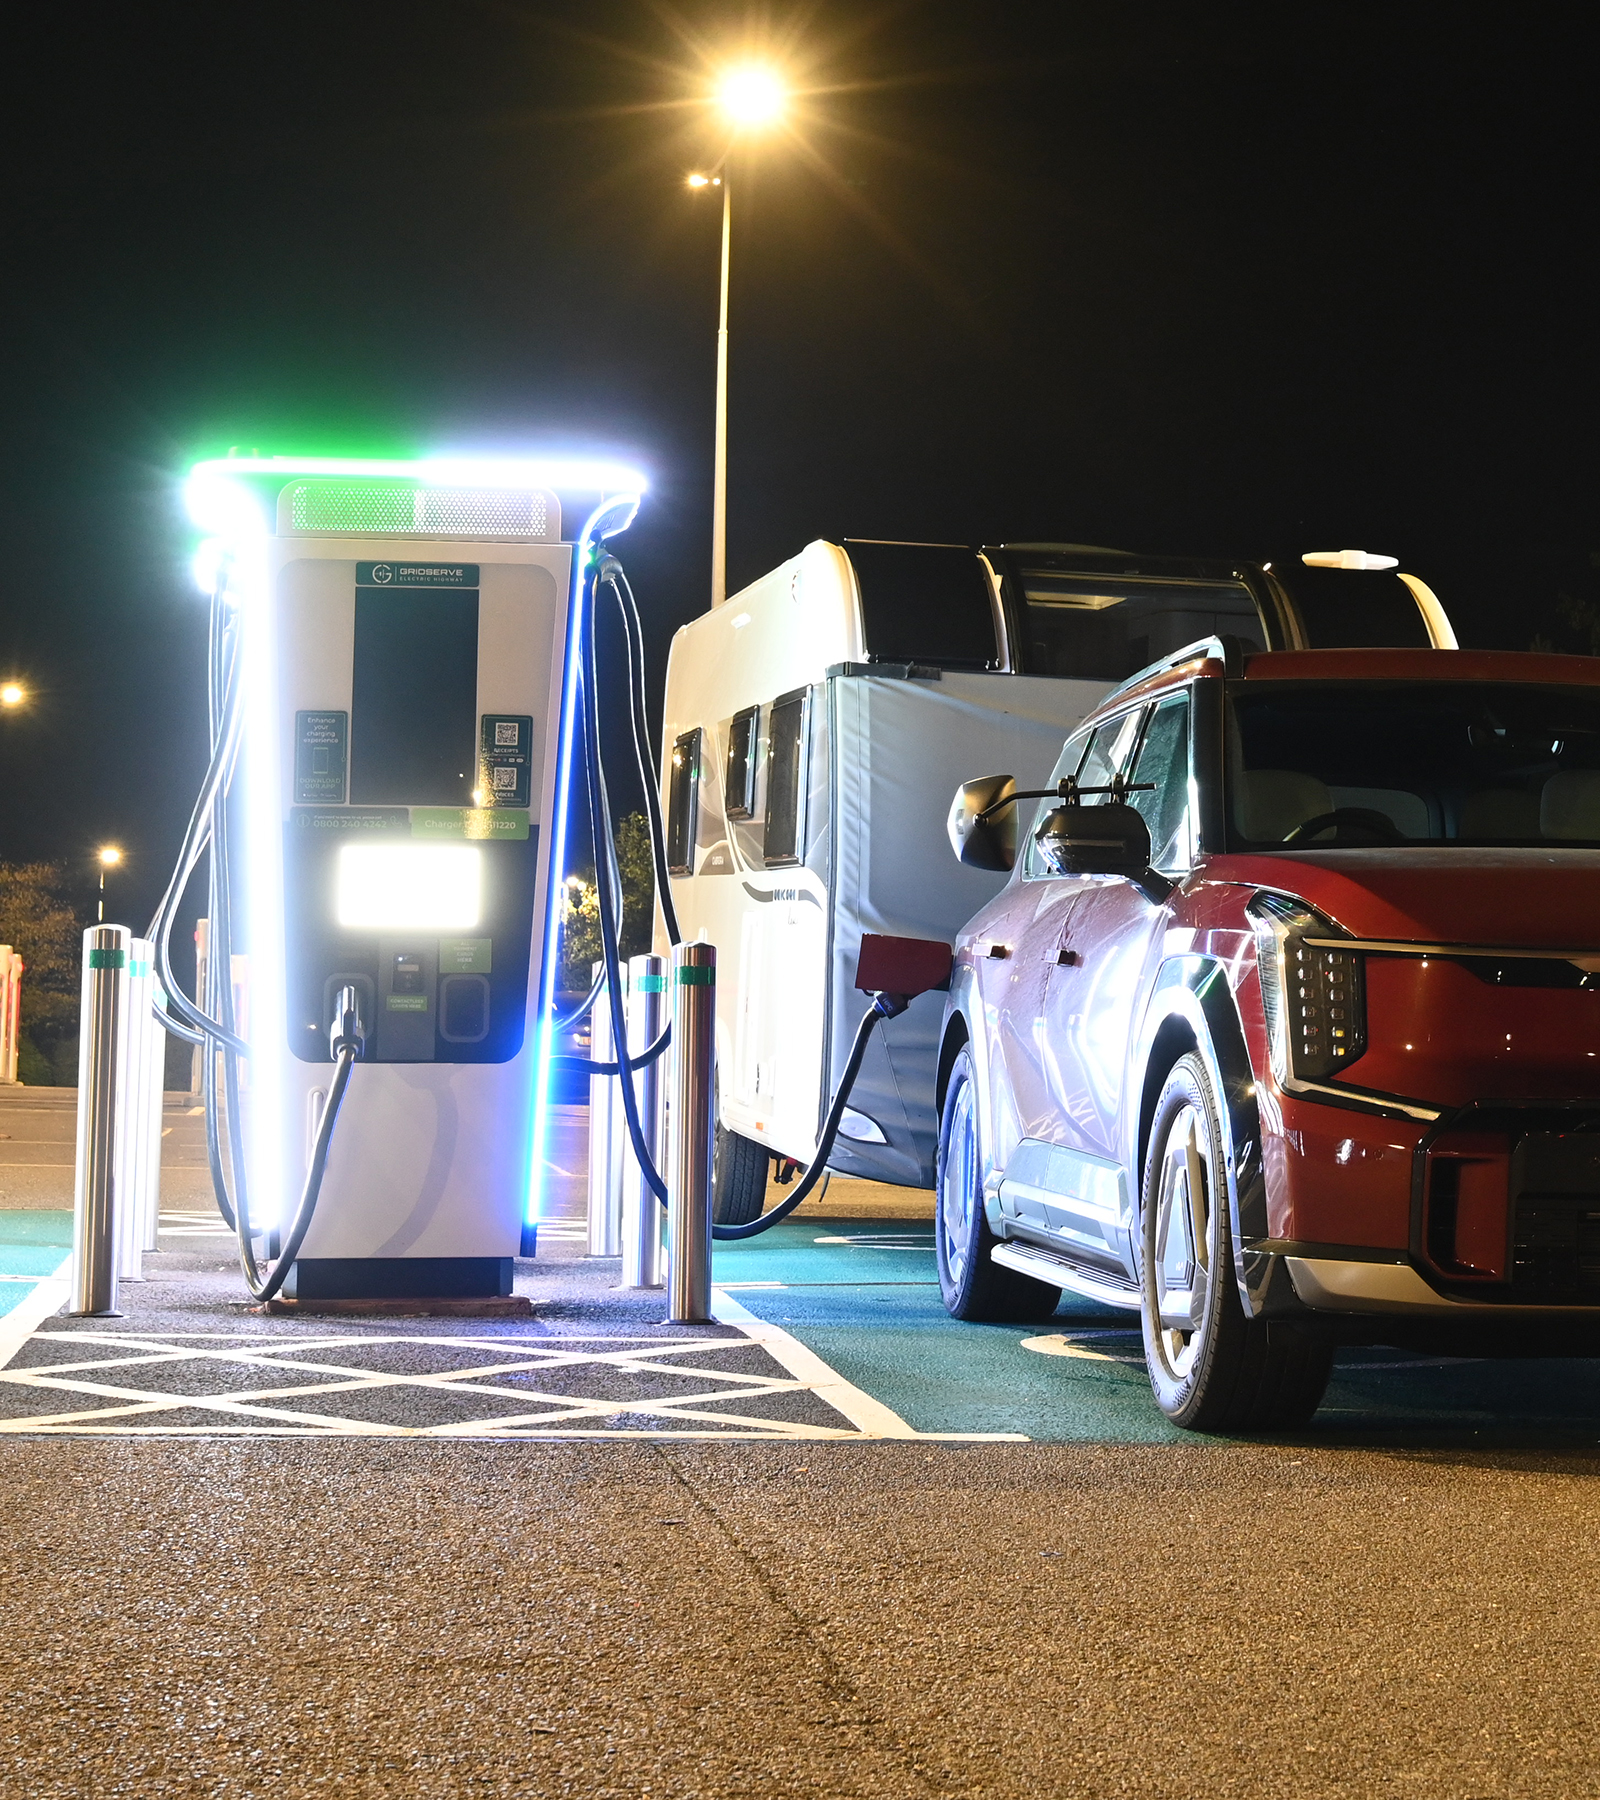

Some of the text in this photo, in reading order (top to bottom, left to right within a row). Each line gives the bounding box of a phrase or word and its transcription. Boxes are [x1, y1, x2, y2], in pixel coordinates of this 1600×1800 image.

[399, 567, 464, 577] GRIDSERVE
[313, 820, 387, 828] 0800 240 4242
[424, 819, 463, 830] Charger
